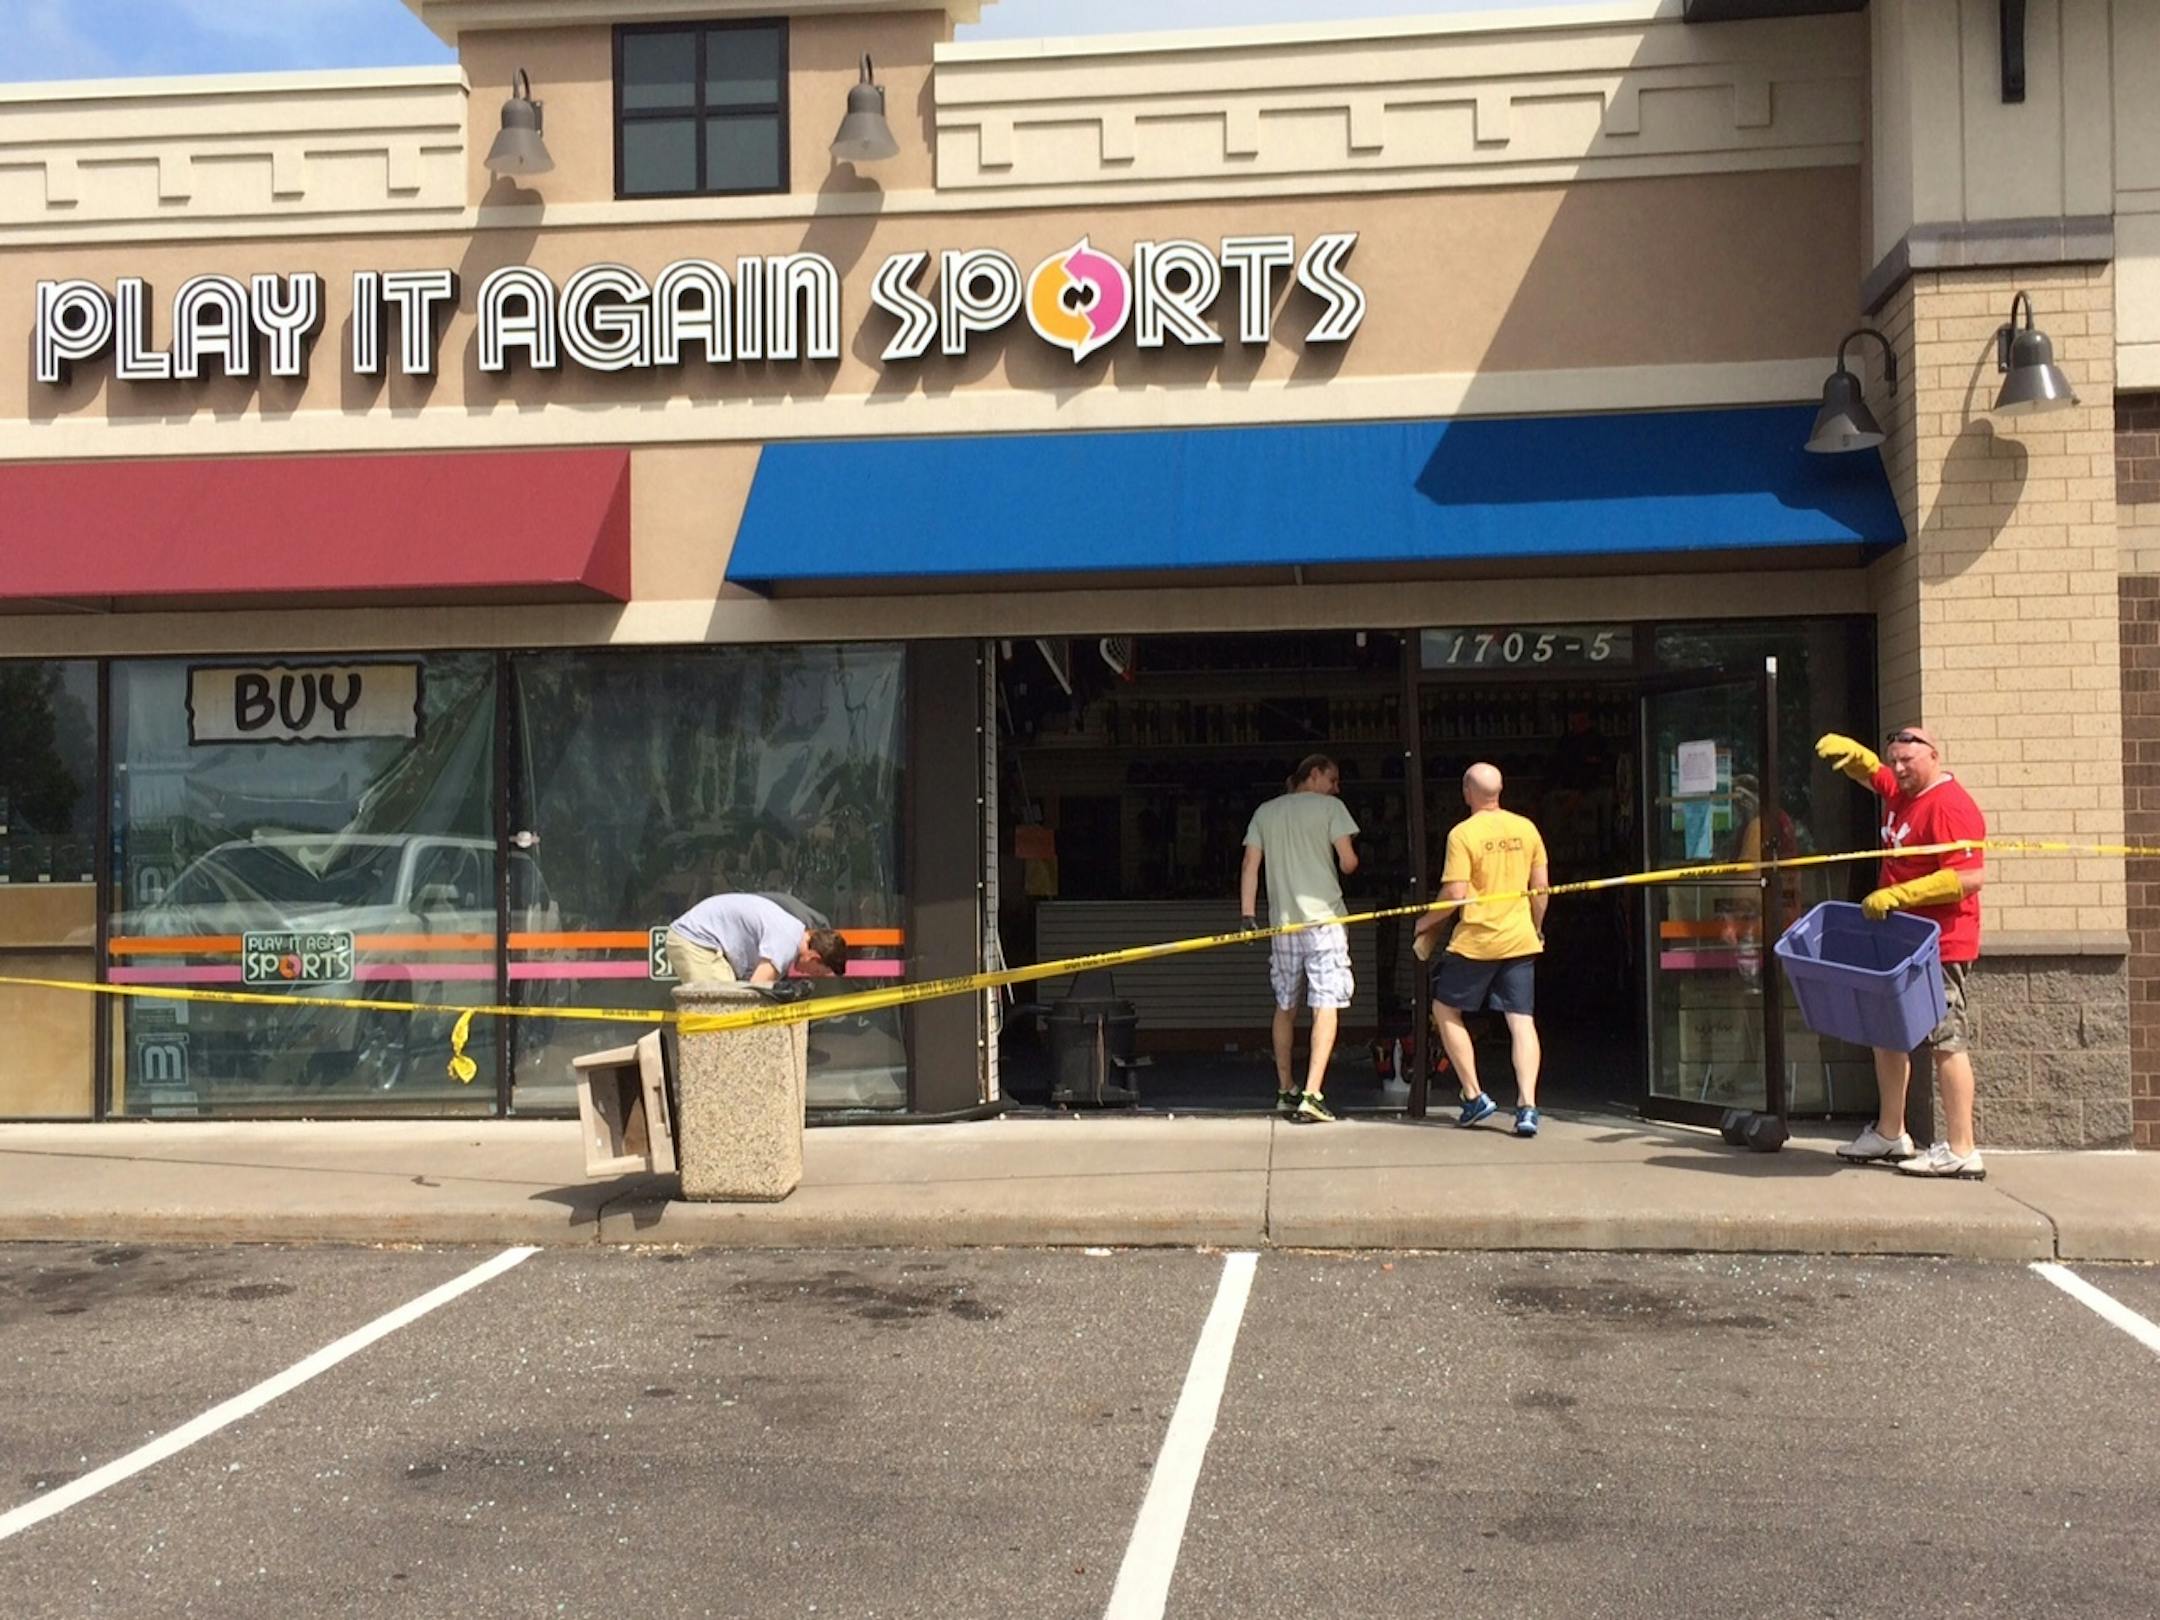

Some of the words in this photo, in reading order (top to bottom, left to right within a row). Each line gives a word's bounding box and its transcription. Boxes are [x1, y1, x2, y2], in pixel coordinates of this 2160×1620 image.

[35, 271, 323, 383] PLAY
[351, 267, 458, 376] IT
[476, 251, 842, 373] AGAIN
[870, 230, 1367, 363] SPORTS
[1446, 631, 1614, 663] 1705-5
[234, 672, 362, 731] BUY
[247, 936, 283, 952] PLAY
[247, 951, 350, 979] SPORTS
